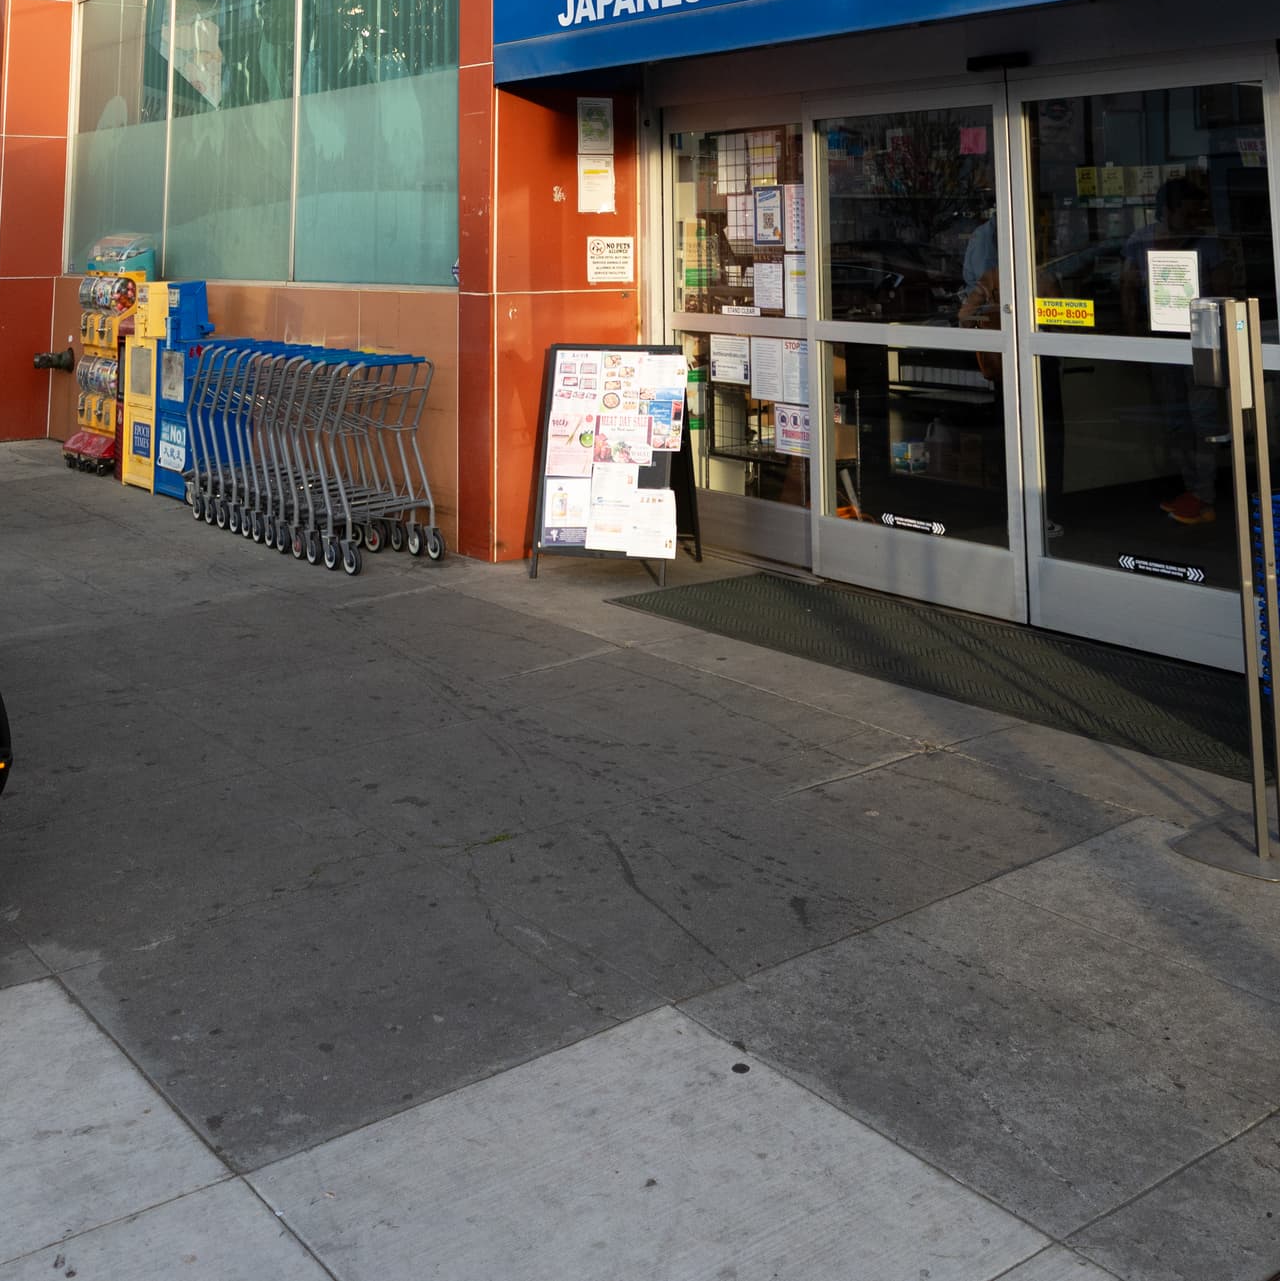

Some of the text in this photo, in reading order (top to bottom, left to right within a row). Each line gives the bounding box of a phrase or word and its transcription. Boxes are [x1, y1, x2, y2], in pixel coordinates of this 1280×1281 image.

[784, 341, 800, 350] STOP
[134, 423, 150, 438] EPOCH
[134, 436, 150, 449] TIMES
